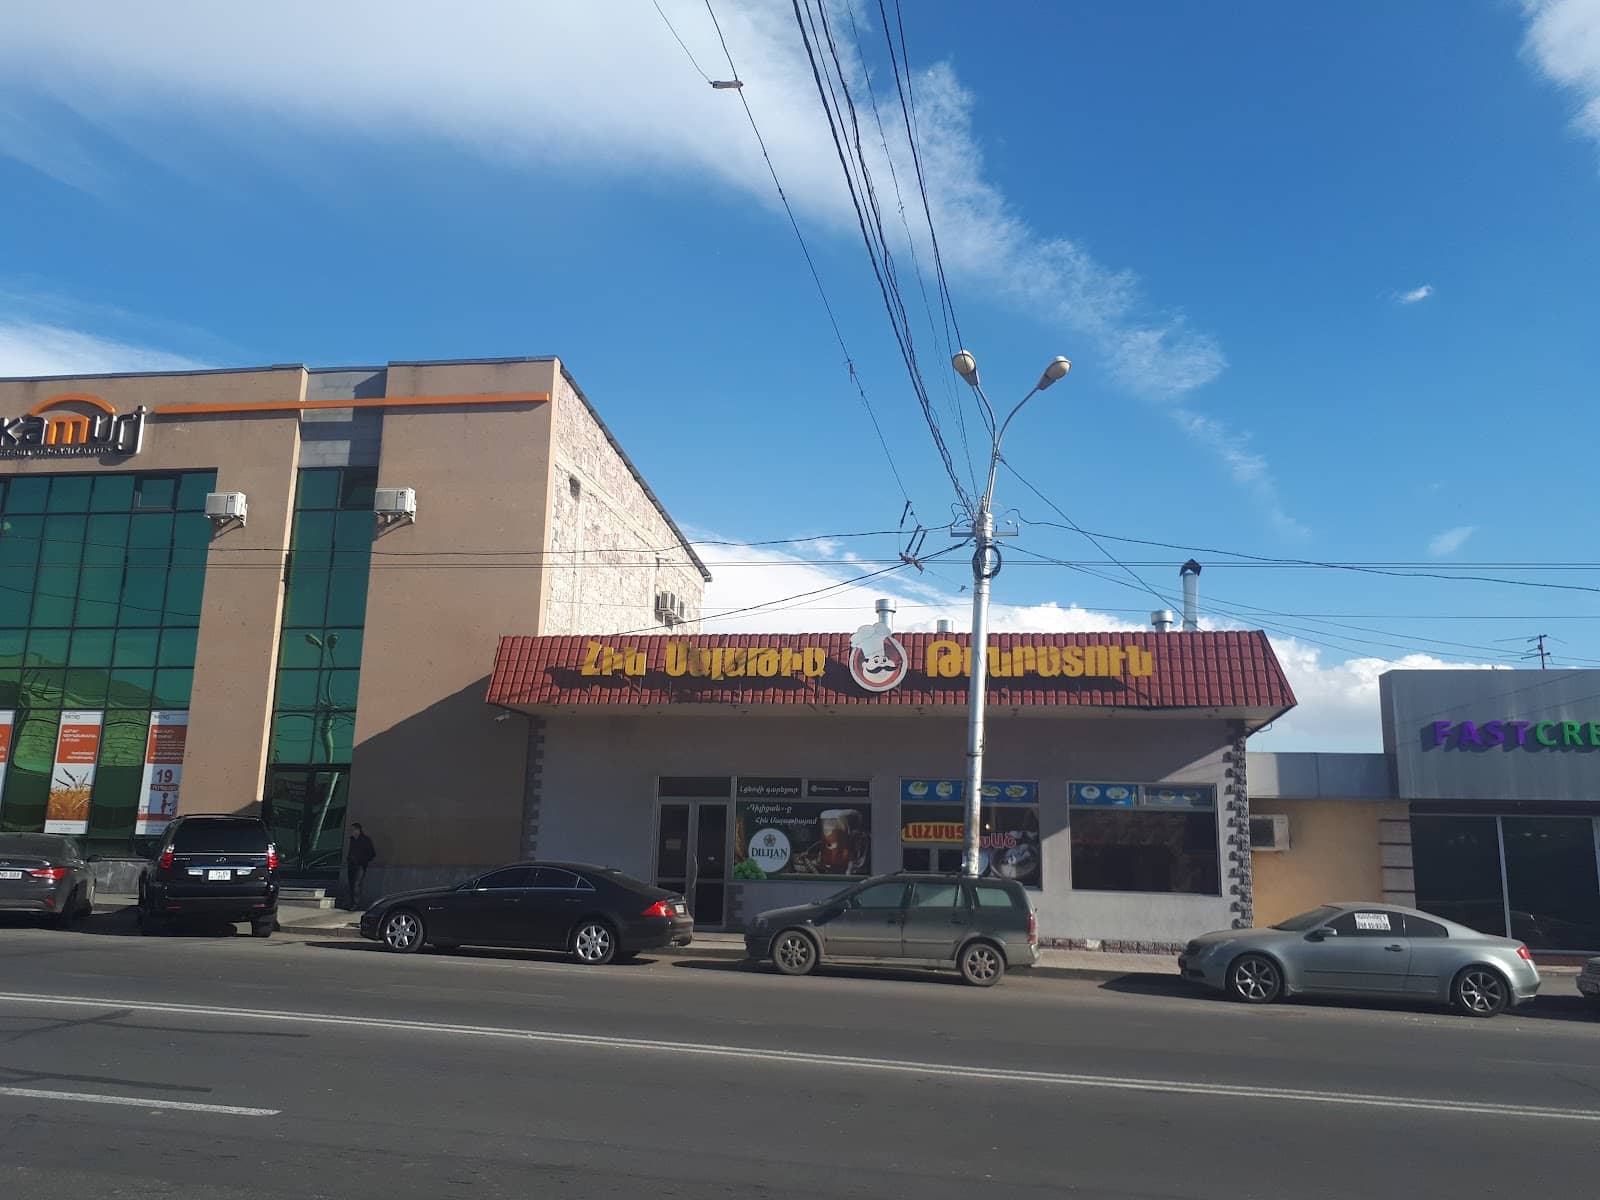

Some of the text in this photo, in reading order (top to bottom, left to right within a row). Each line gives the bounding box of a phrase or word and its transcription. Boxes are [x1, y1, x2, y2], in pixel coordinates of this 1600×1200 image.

[581, 640, 646, 676] Հին
[156, 769, 173, 784] 19
[751, 847, 788, 860] DILIJAN
